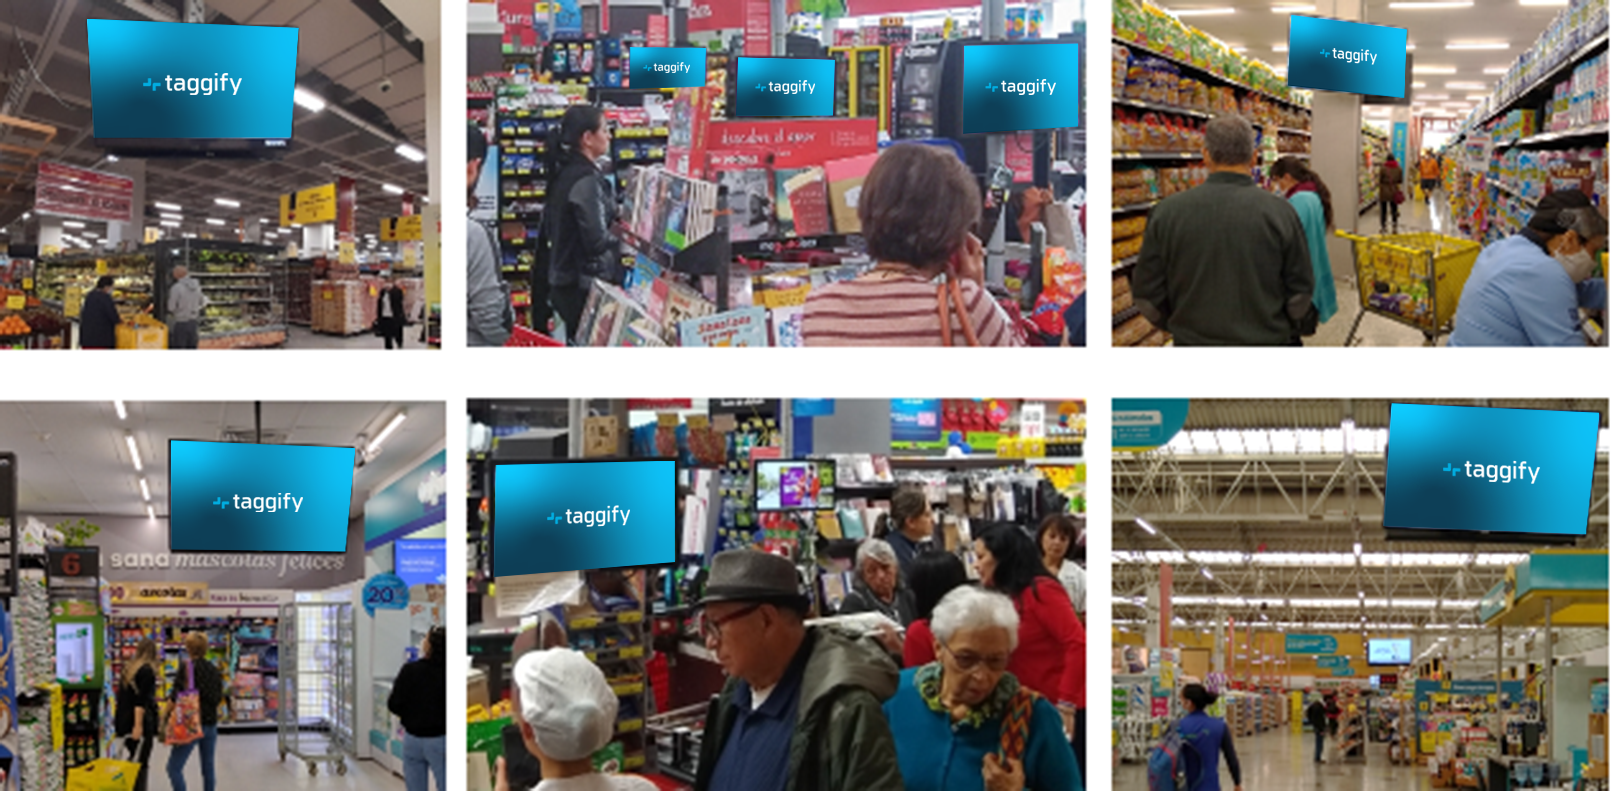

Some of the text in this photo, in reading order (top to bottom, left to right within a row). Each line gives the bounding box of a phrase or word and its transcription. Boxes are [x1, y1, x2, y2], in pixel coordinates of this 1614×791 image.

[653, 60, 691, 74] taggify
[1331, 47, 1378, 66] taggify
[164, 72, 243, 96] taggify
[768, 79, 816, 95] taggify
[1000, 77, 1057, 96] taggify
[1464, 460, 1541, 485] taggify
[232, 491, 304, 513] taggify
[565, 504, 631, 528] taggify
[61, 552, 81, 576] 6
[110, 552, 170, 568] sana
[175, 552, 277, 568] mascotas
[278, 552, 346, 578] felices
